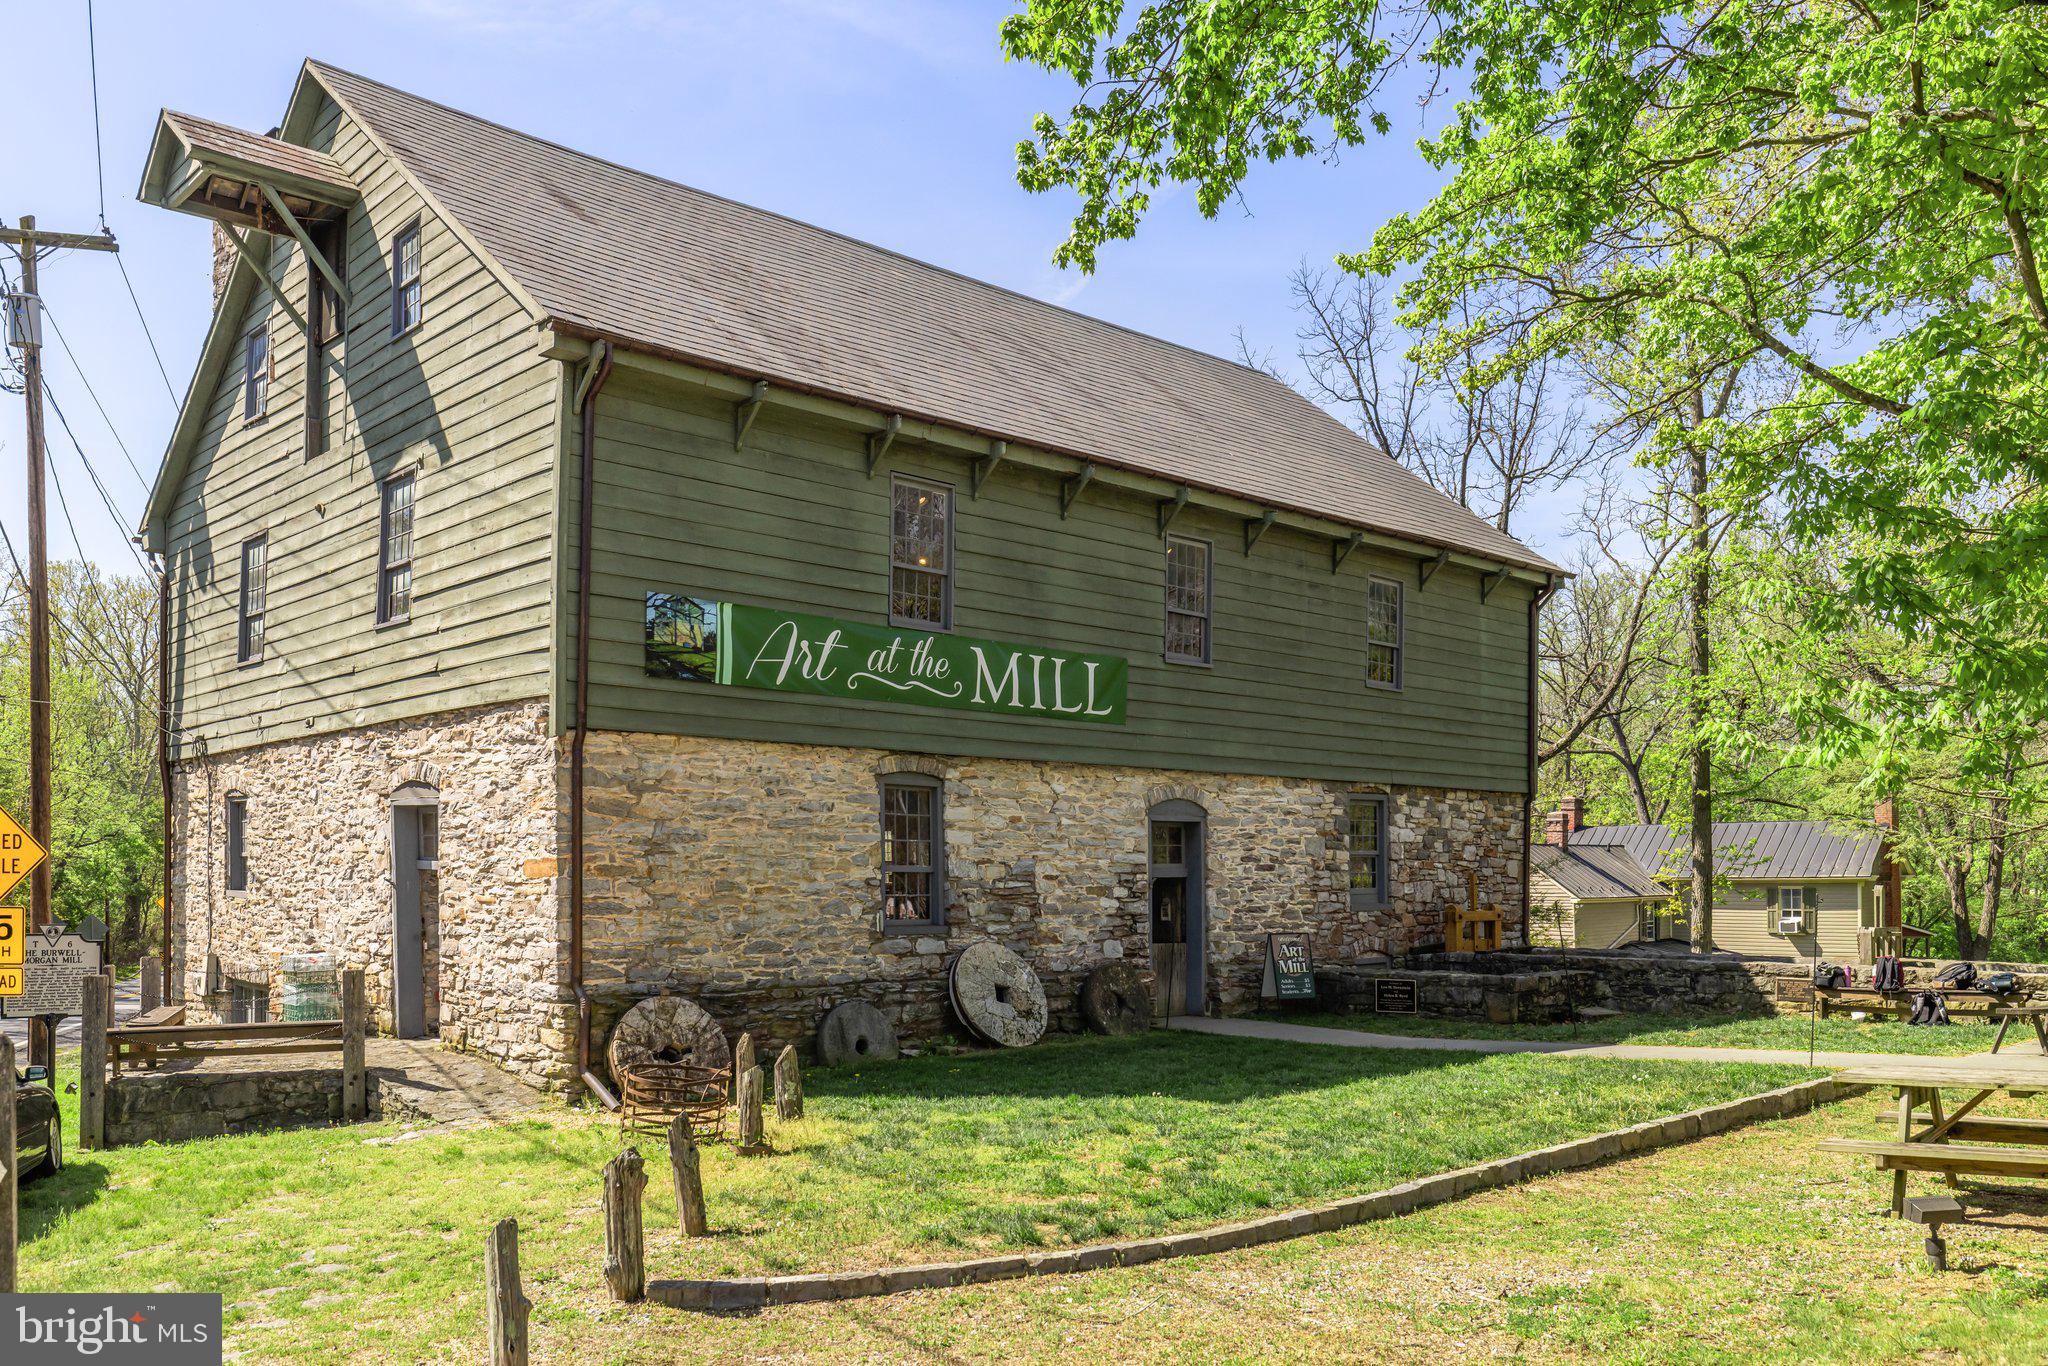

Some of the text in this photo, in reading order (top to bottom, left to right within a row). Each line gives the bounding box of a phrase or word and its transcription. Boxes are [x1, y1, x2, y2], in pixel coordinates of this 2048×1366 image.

[746, 621, 1113, 716] Art at the MILL
[25, 949, 86, 957] HE BURWELL-
[1278, 944, 1304, 958] ART
[62, 956, 83, 964] MILL
[1278, 960, 1310, 974] MILL
